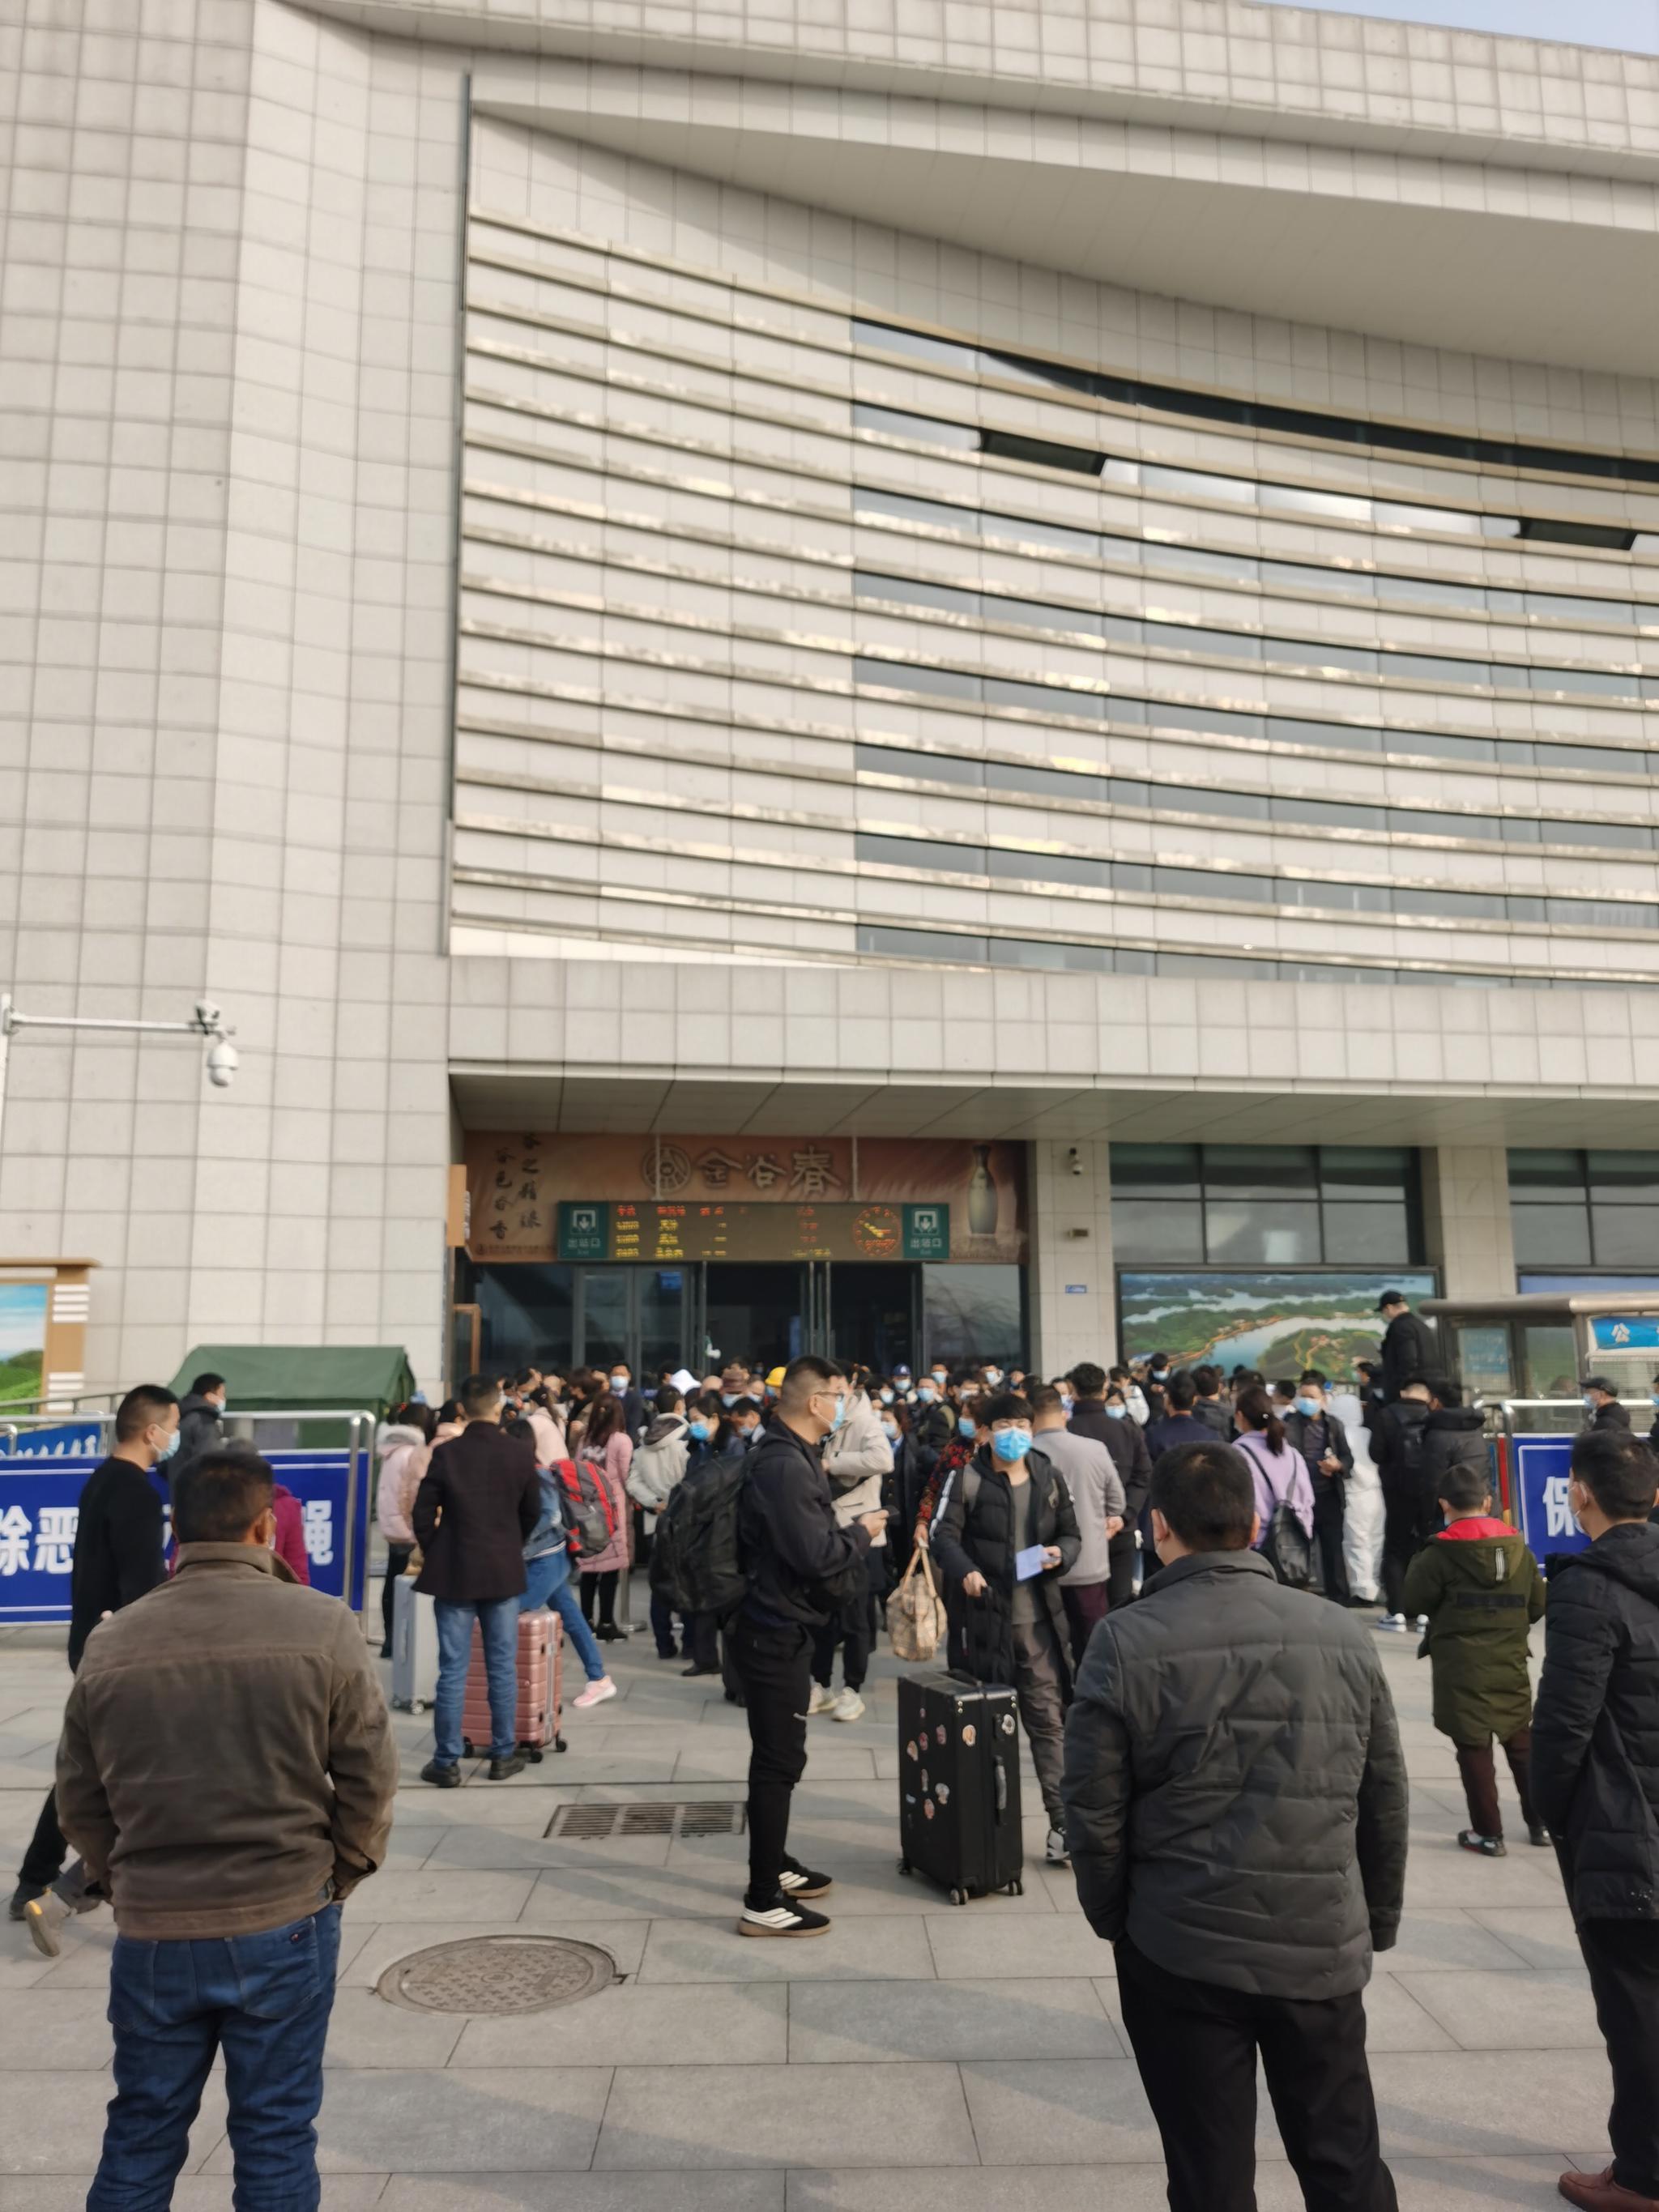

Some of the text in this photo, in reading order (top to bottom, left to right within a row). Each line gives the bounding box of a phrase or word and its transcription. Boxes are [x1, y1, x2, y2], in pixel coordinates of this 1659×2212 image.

[696, 1143, 842, 1196] 金谷春
[567, 1237, 601, 1249] 出站口
[910, 1238, 942, 1249] 出站口
[0, 1505, 79, 1576] 除恶
